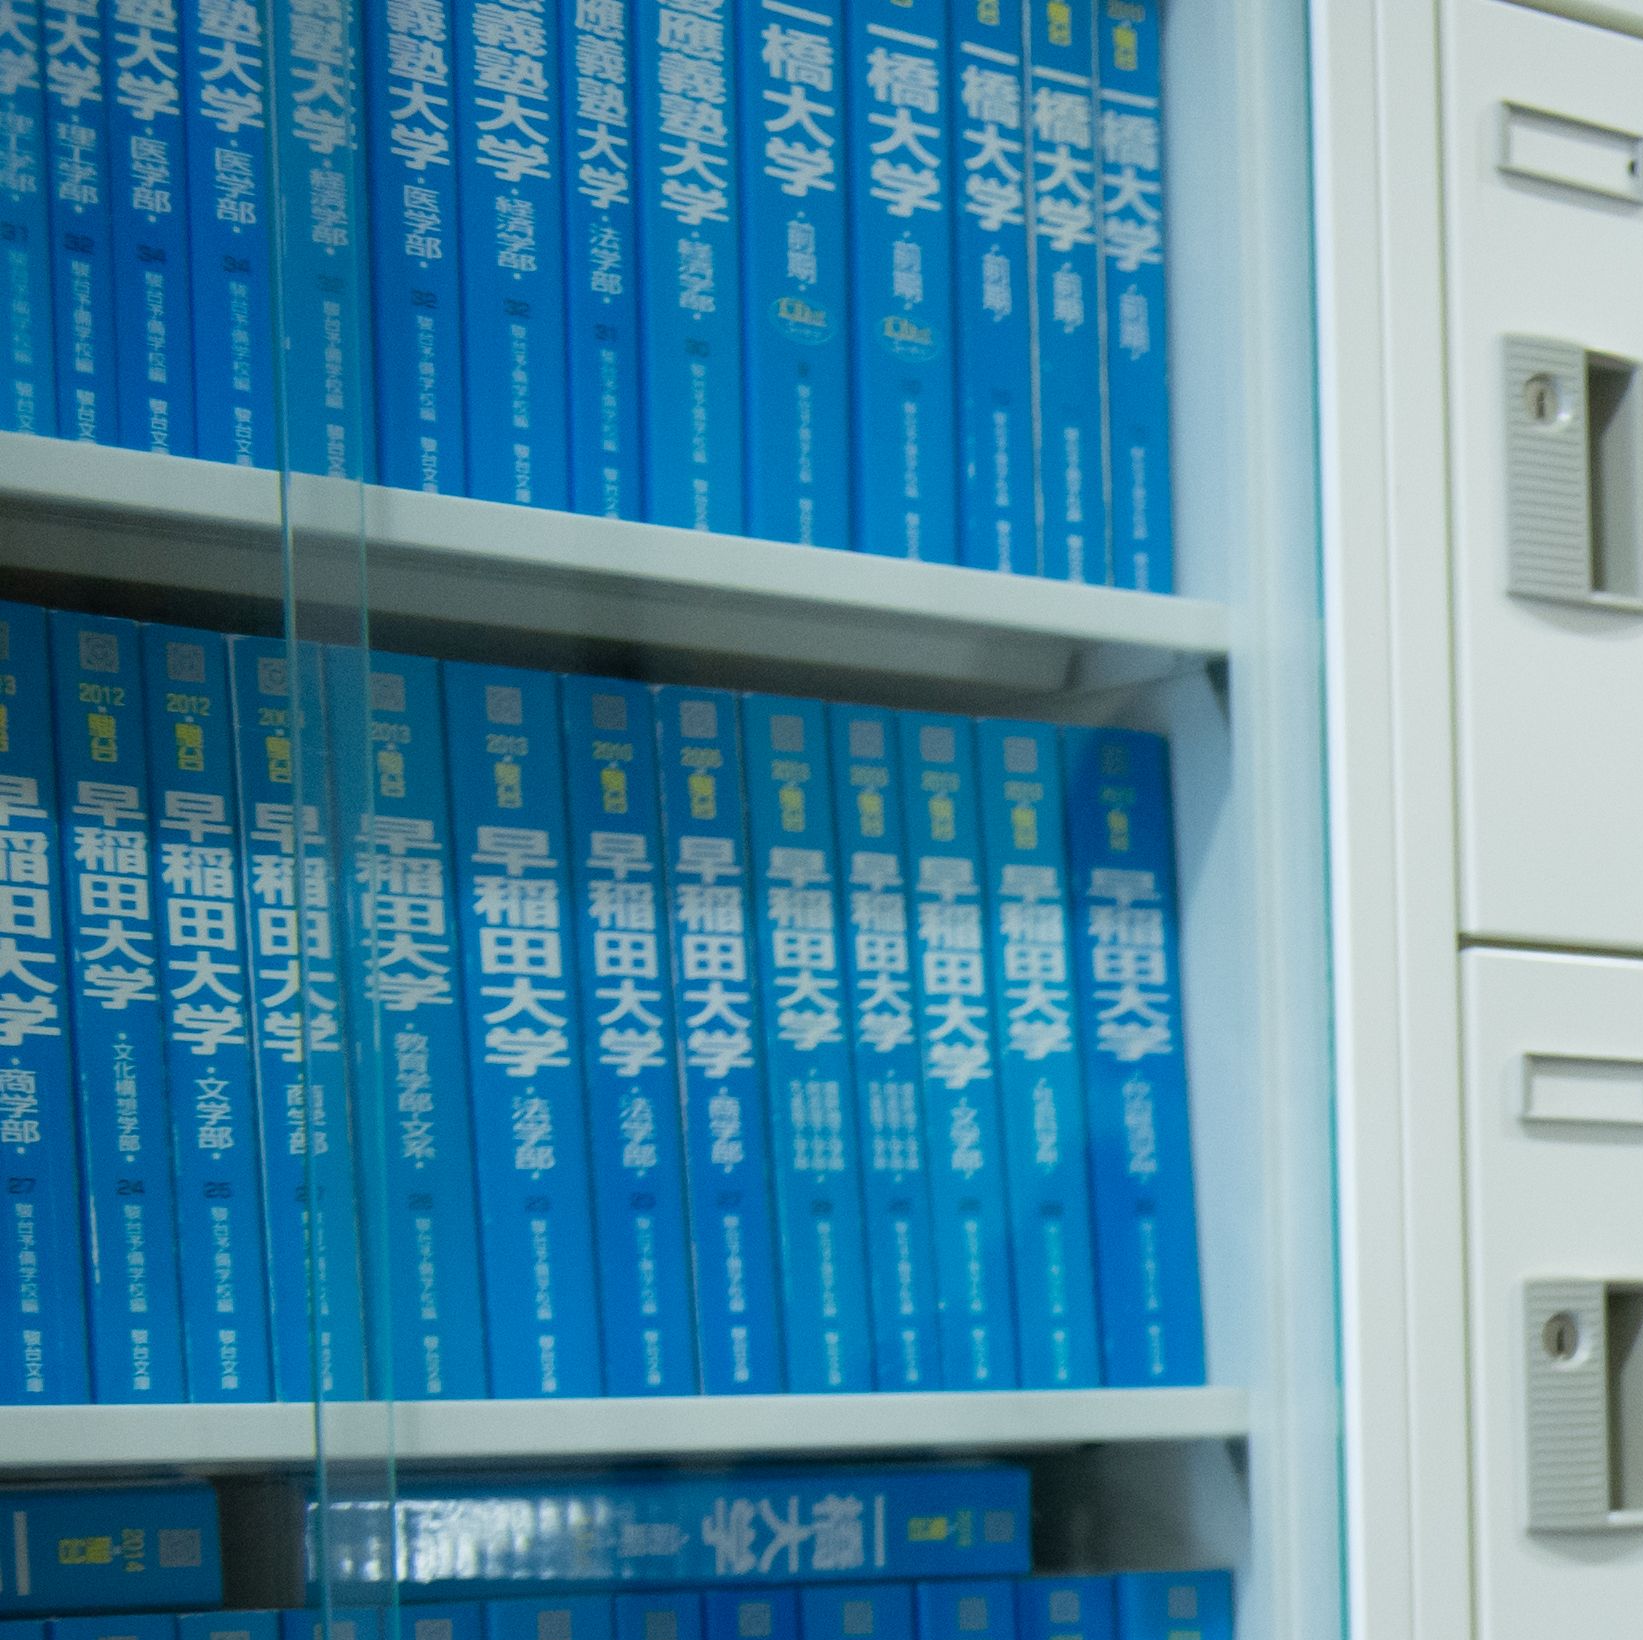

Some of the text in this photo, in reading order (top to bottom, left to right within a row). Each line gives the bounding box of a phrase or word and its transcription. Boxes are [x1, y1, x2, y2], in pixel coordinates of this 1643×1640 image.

[130, 136, 172, 213] 医学部
[214, 147, 256, 224] 医学部
[761, 0, 836, 197] 一橋大学
[866, 22, 943, 218] 一橋大学
[960, 40, 1026, 232] 一橋大学
[1031, 65, 1098, 252] 一橋大学
[1101, 88, 1164, 273] 一橋大学
[403, 184, 442, 260] 医学部
[79, 682, 126, 707] 2012
[72, 781, 160, 1010] 早稲田大学
[159, 791, 248, 1151] 早稲田大学 文学部
[354, 814, 454, 1012] 早稲田大学
[471, 826, 571, 1078] 早稲田大学
[586, 832, 667, 1078] 早稲田大学
[676, 836, 756, 1079] 早稲田大学
[767, 847, 845, 1052] 早稲田大学
[850, 852, 915, 1053] 早稲田大学
[916, 857, 993, 1090] 早稲田大学
[1000, 865, 1073, 1061] 早稲田大学
[1087, 868, 1173, 1062] 早稲田大学
[0, 1067, 41, 1145] 商学部
